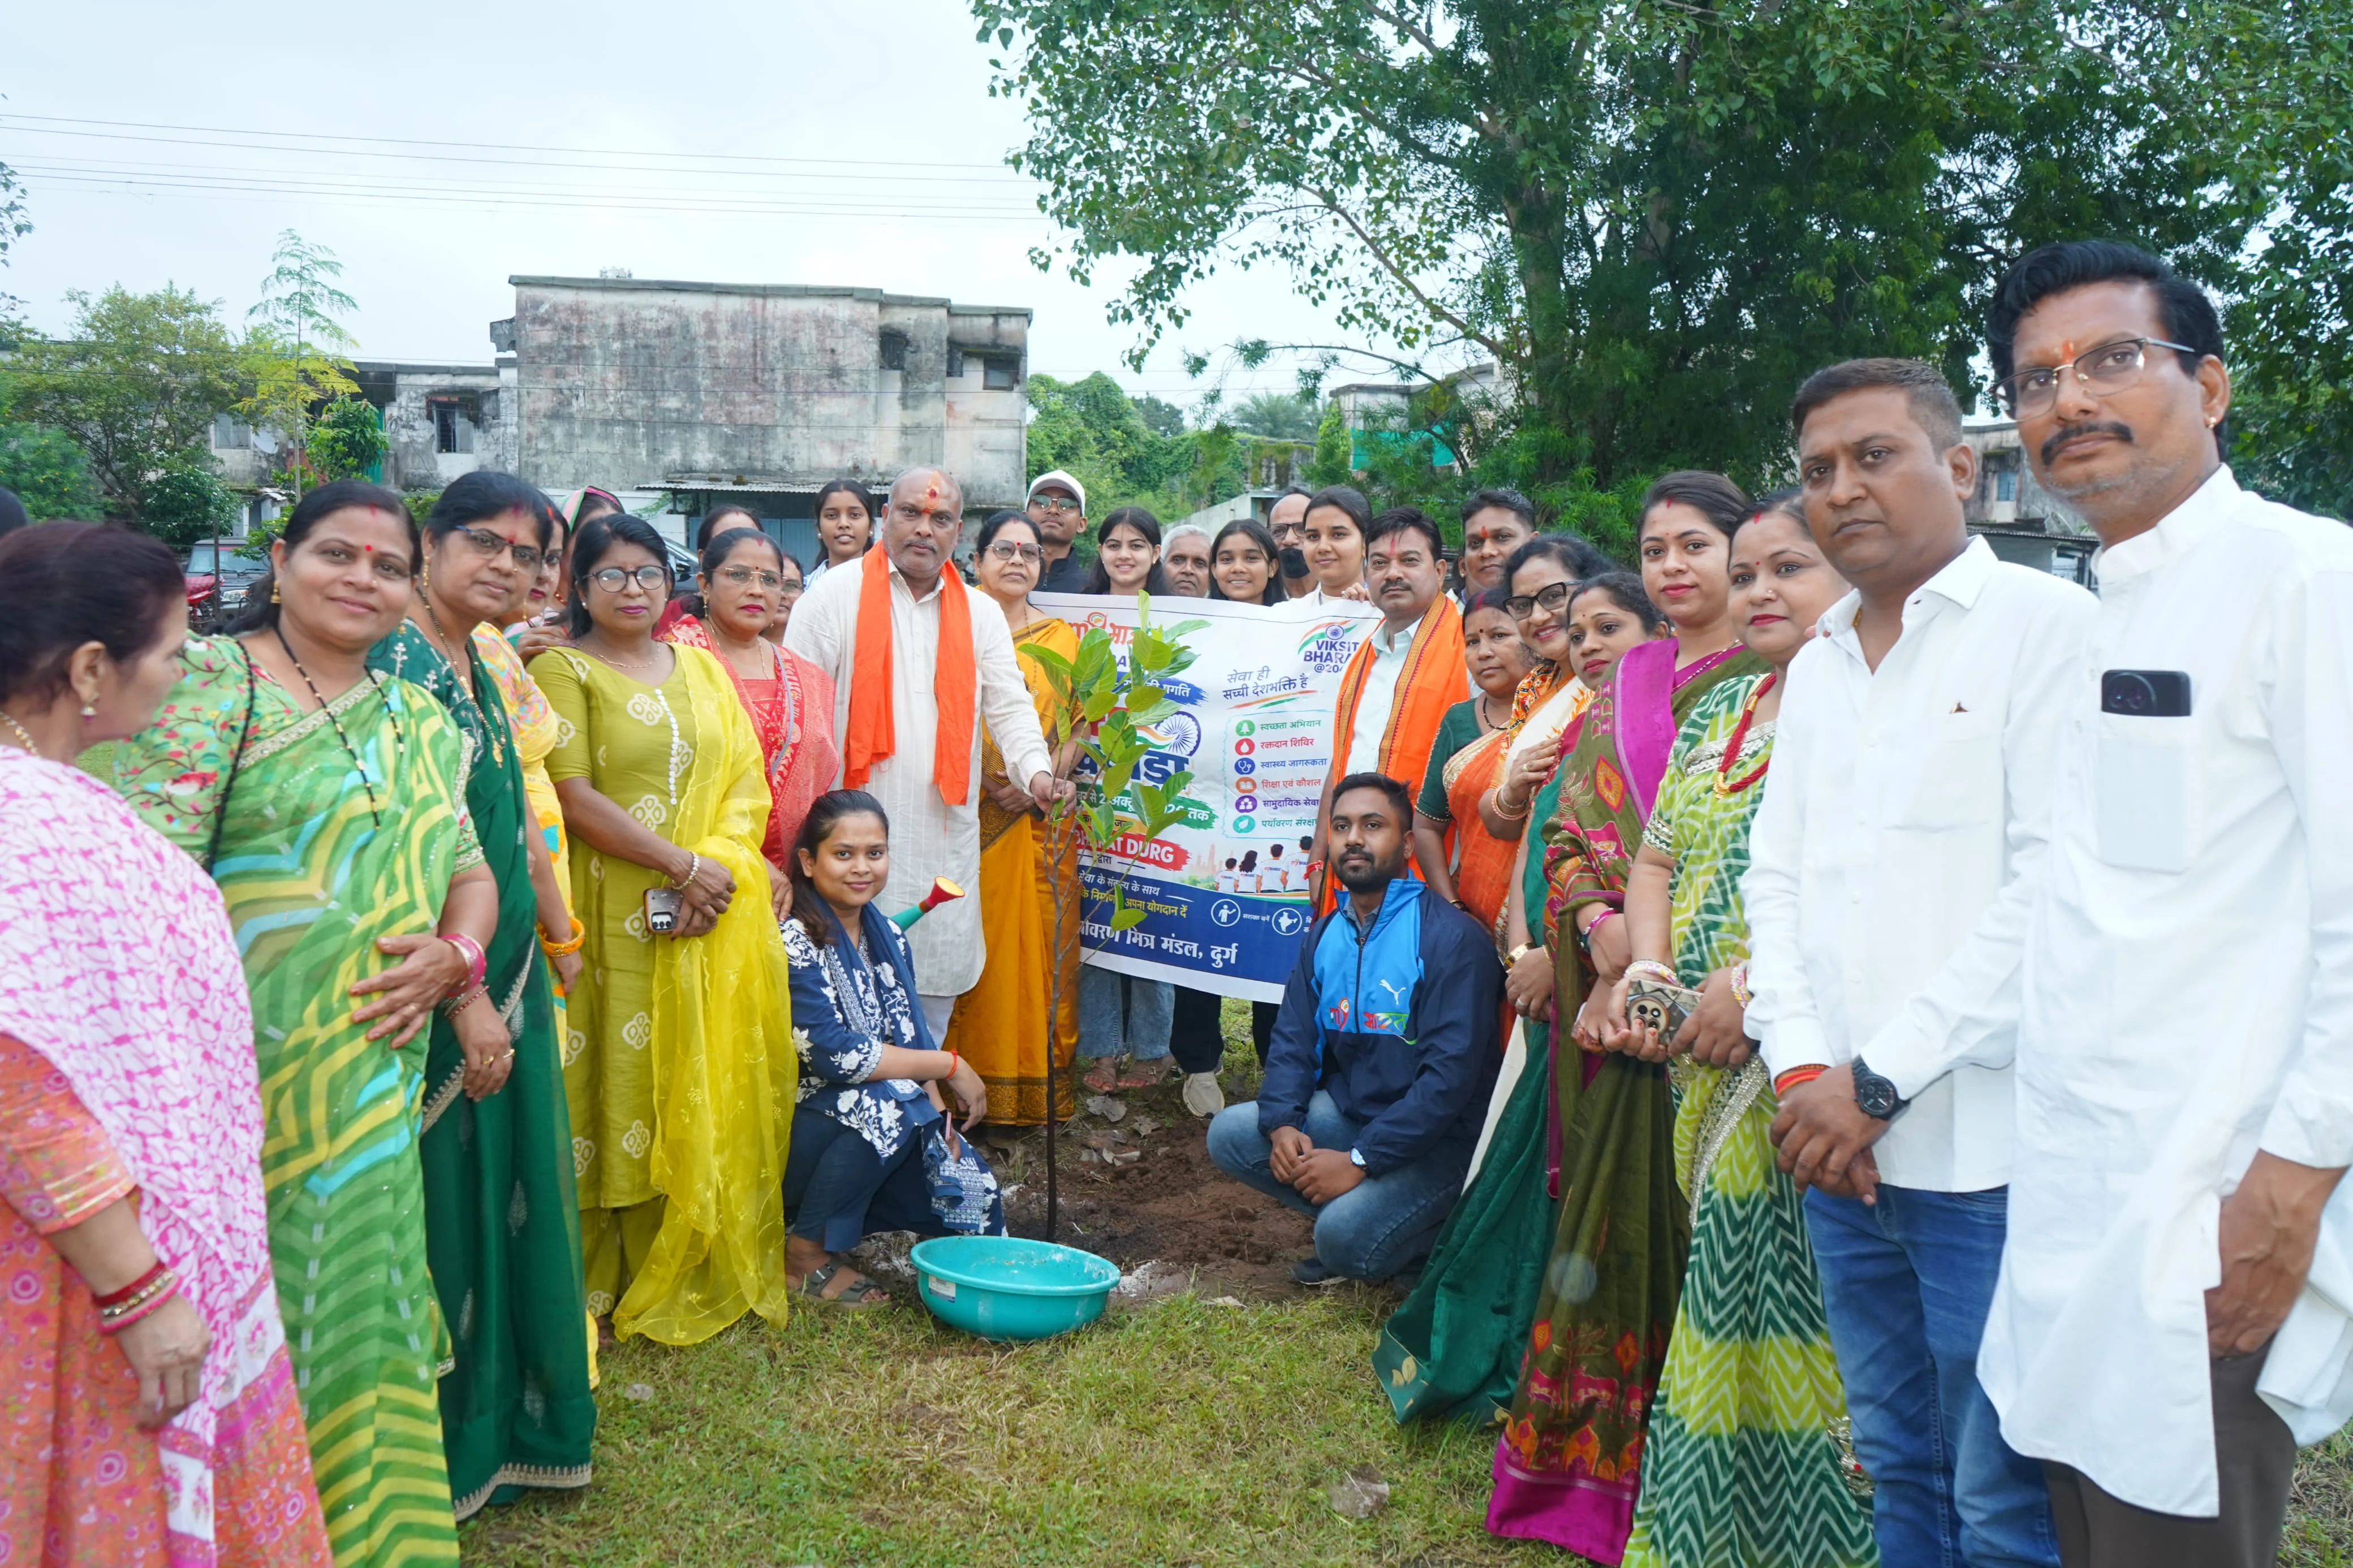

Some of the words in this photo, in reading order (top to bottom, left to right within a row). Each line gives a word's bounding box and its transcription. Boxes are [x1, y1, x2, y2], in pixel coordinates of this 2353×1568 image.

[1316, 640, 1360, 652] VIKSIT
[1227, 669, 1253, 683] सेवा
[1257, 666, 1271, 681] ही
[1314, 663, 1343, 673] @20
[1222, 683, 1249, 699] सच्ची
[1253, 676, 1297, 696] देशभक्ति
[1299, 673, 1308, 688] है
[1260, 740, 1288, 749] रक्तदान
[1290, 736, 1314, 747] शिविर
[1261, 779, 1281, 788] शिक्षा
[1282, 779, 1294, 788] एवं
[1296, 777, 1321, 786] कौशल
[1262, 797, 1301, 809] सामुदायिक
[1303, 797, 1319, 806] सेवा
[1188, 807, 1210, 821] तक
[1262, 818, 1292, 828] पर्यावरण
[1127, 838, 1174, 863] DURG
[1078, 870, 1096, 883] सेवा
[1098, 873, 1106, 884] के
[1131, 880, 1140, 893] के
[1141, 885, 1161, 896] साथ
[1125, 898, 1145, 910] अपना
[1147, 900, 1178, 916] योगदान
[1126, 926, 1156, 949] मित्र
[1161, 934, 1203, 959] मंडल,
[1210, 943, 1238, 968] दुर्ग
